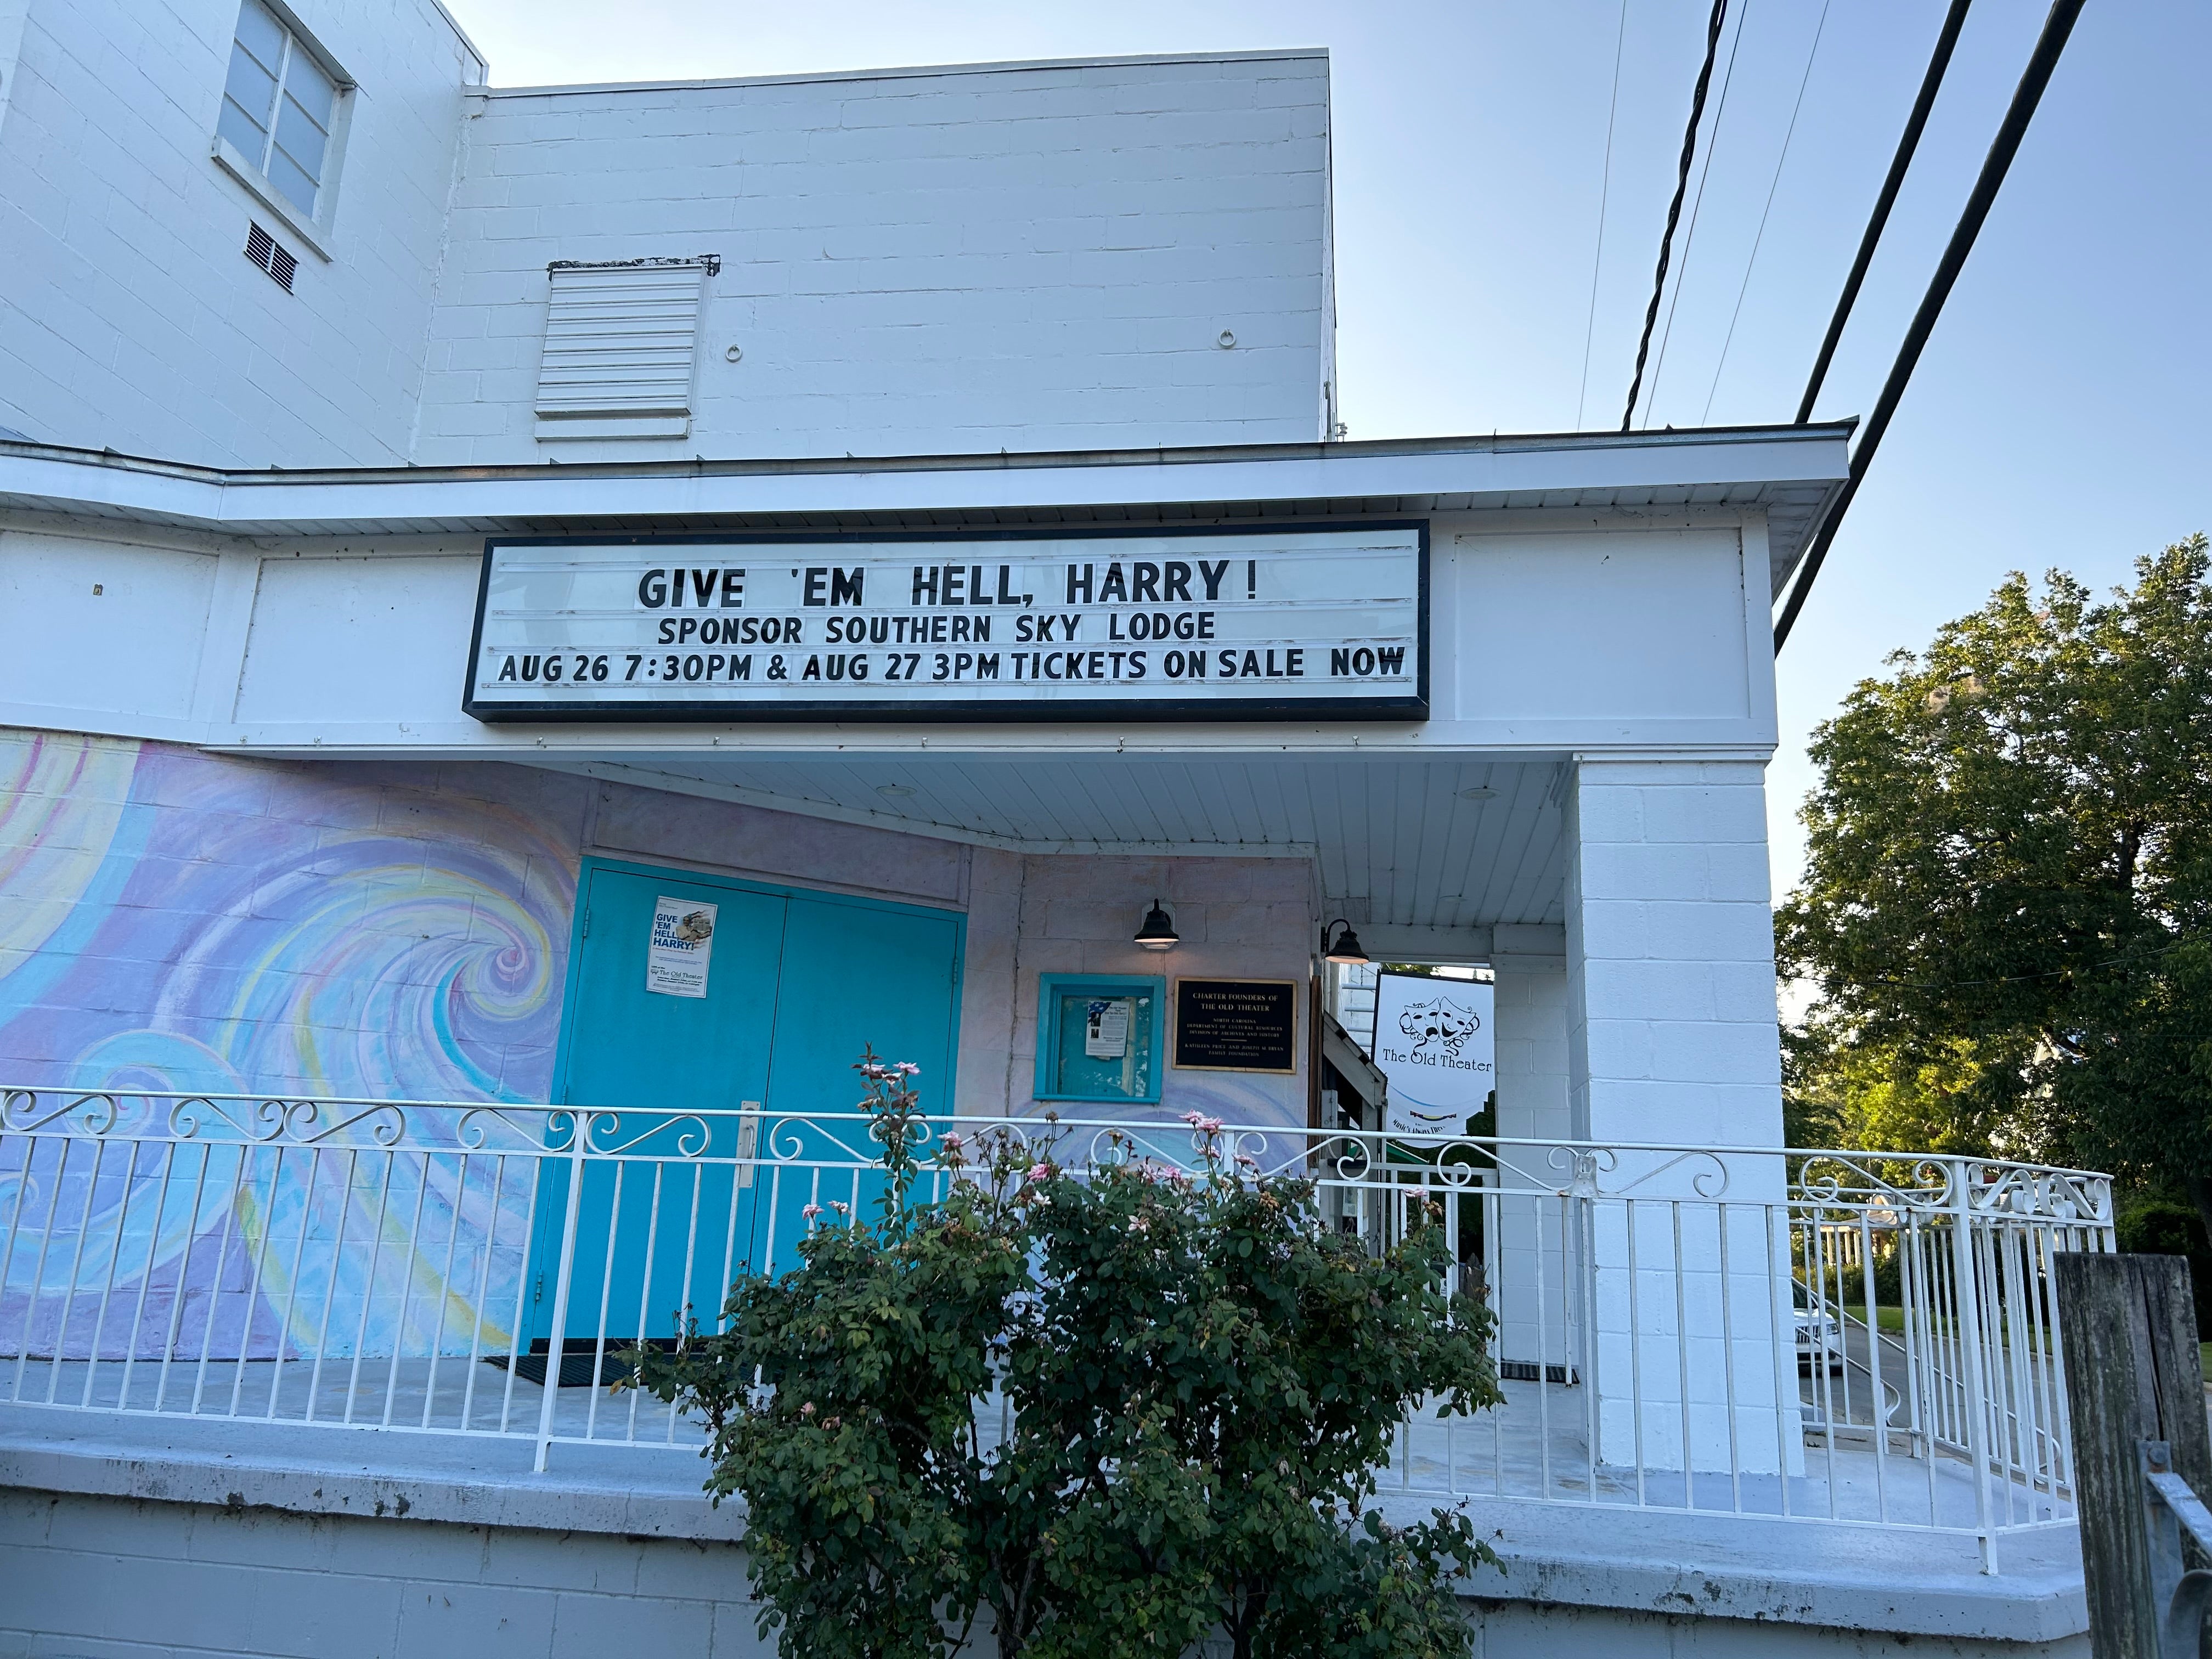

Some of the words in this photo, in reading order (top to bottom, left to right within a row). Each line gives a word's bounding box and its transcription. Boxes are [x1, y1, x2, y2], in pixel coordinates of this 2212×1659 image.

[639, 568, 746, 608] GIVE
[791, 567, 864, 606] 'EM
[912, 563, 1033, 608] HELL,
[1066, 560, 1256, 603] HARRY!
[658, 617, 802, 645] SPONSOR
[826, 615, 990, 643] SOUTHERN
[1015, 614, 1082, 641] SKY
[1109, 611, 1215, 640] LODGE
[498, 654, 562, 681] AUG
[573, 654, 608, 681] 26
[625, 654, 752, 681] 7:30PM
[767, 654, 788, 680] &
[802, 653, 868, 680] AUG
[884, 653, 921, 680] 27
[932, 652, 1000, 680] 3PM
[1010, 651, 1147, 679] TICKETS
[1164, 650, 1206, 678] ON
[1218, 649, 1304, 678] SALE
[1331, 646, 1405, 676] NOW
[656, 921, 670, 930] 'EM
[657, 913, 678, 923] GIVE
[653, 937, 695, 951] HARRY!
[654, 929, 679, 940] HELL,
[1383, 1048, 1407, 1063] The
[1410, 1051, 1436, 1066] Old
[1440, 1054, 1492, 1072] Theater
